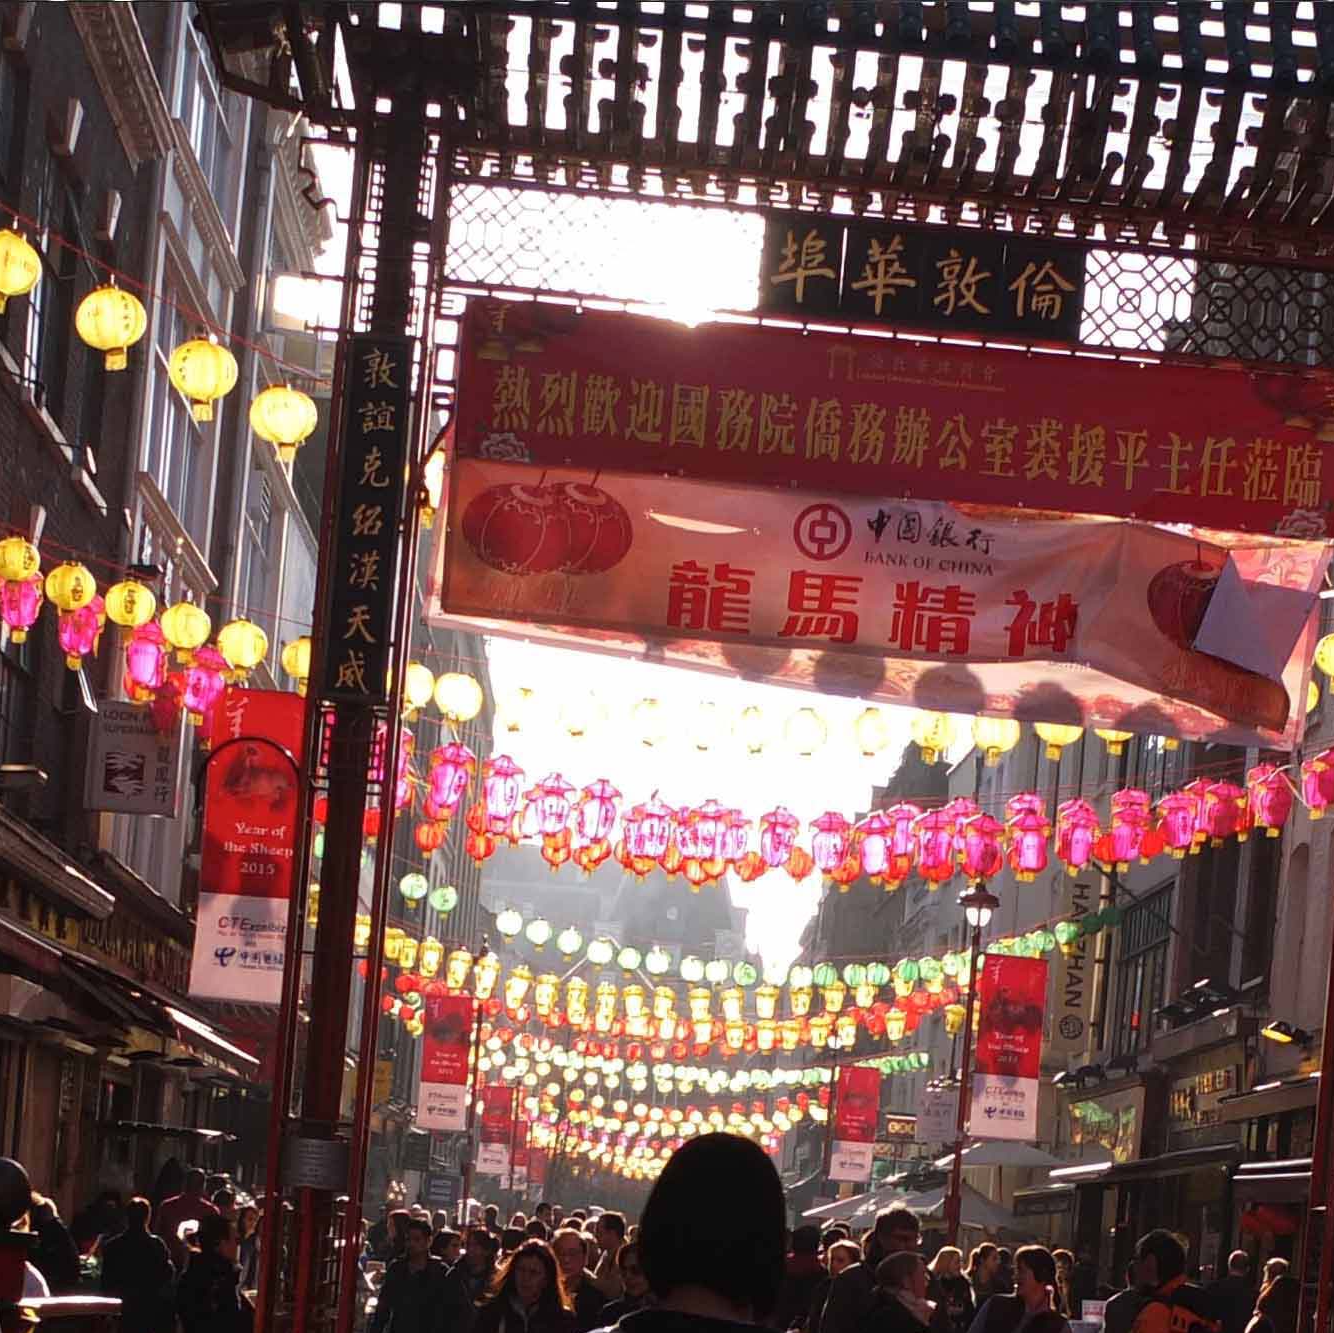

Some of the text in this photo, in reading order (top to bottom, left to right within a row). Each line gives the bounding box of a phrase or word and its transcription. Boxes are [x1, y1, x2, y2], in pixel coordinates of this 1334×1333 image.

[334, 348, 400, 694] 敦誼克紹漢天威
[864, 550, 995, 578] BANK OF CHINA
[665, 559, 1081, 657] 龍馬精神
[235, 822, 287, 839] Year of
[224, 840, 294, 858] the Sheep
[240, 861, 275, 875] 2015
